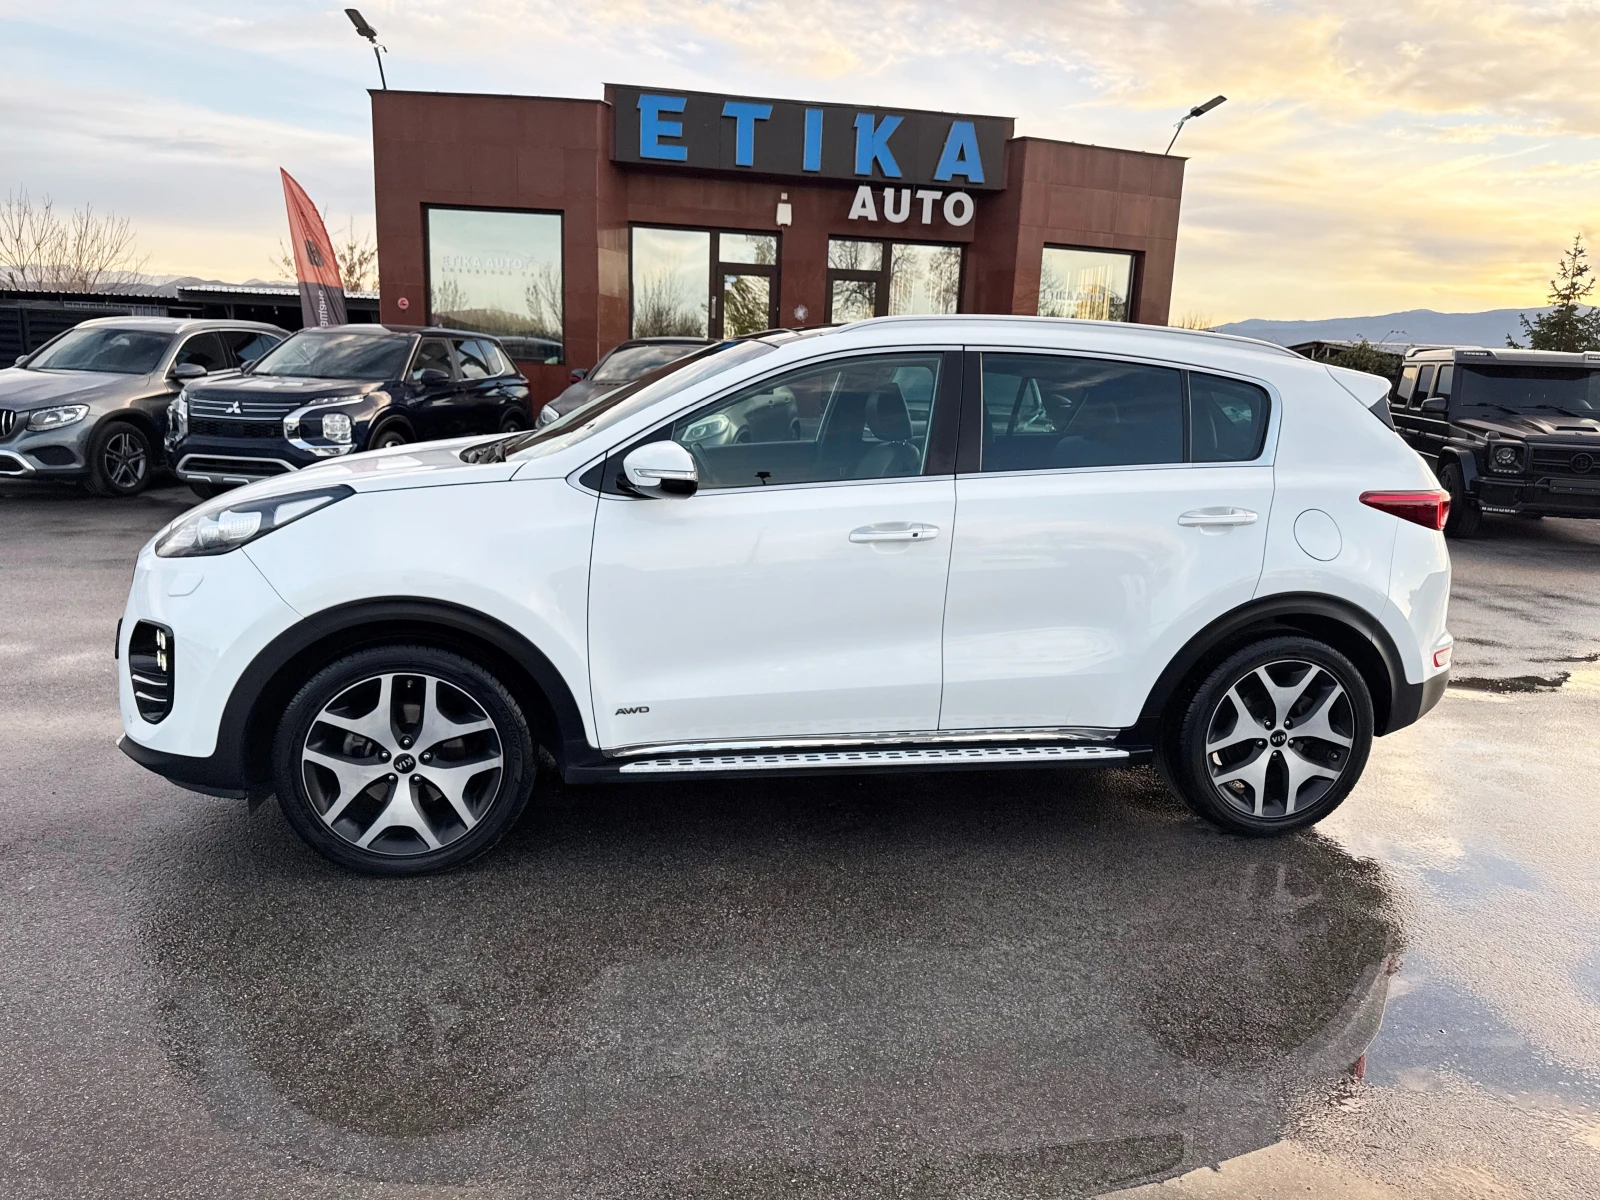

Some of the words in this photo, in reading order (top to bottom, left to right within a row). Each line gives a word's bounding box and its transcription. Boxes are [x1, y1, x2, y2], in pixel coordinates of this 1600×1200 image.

[637, 93, 985, 183] ETIKA
[848, 185, 975, 227] AUTO
[486, 257, 524, 270] AUTO
[615, 706, 650, 716] AWD
